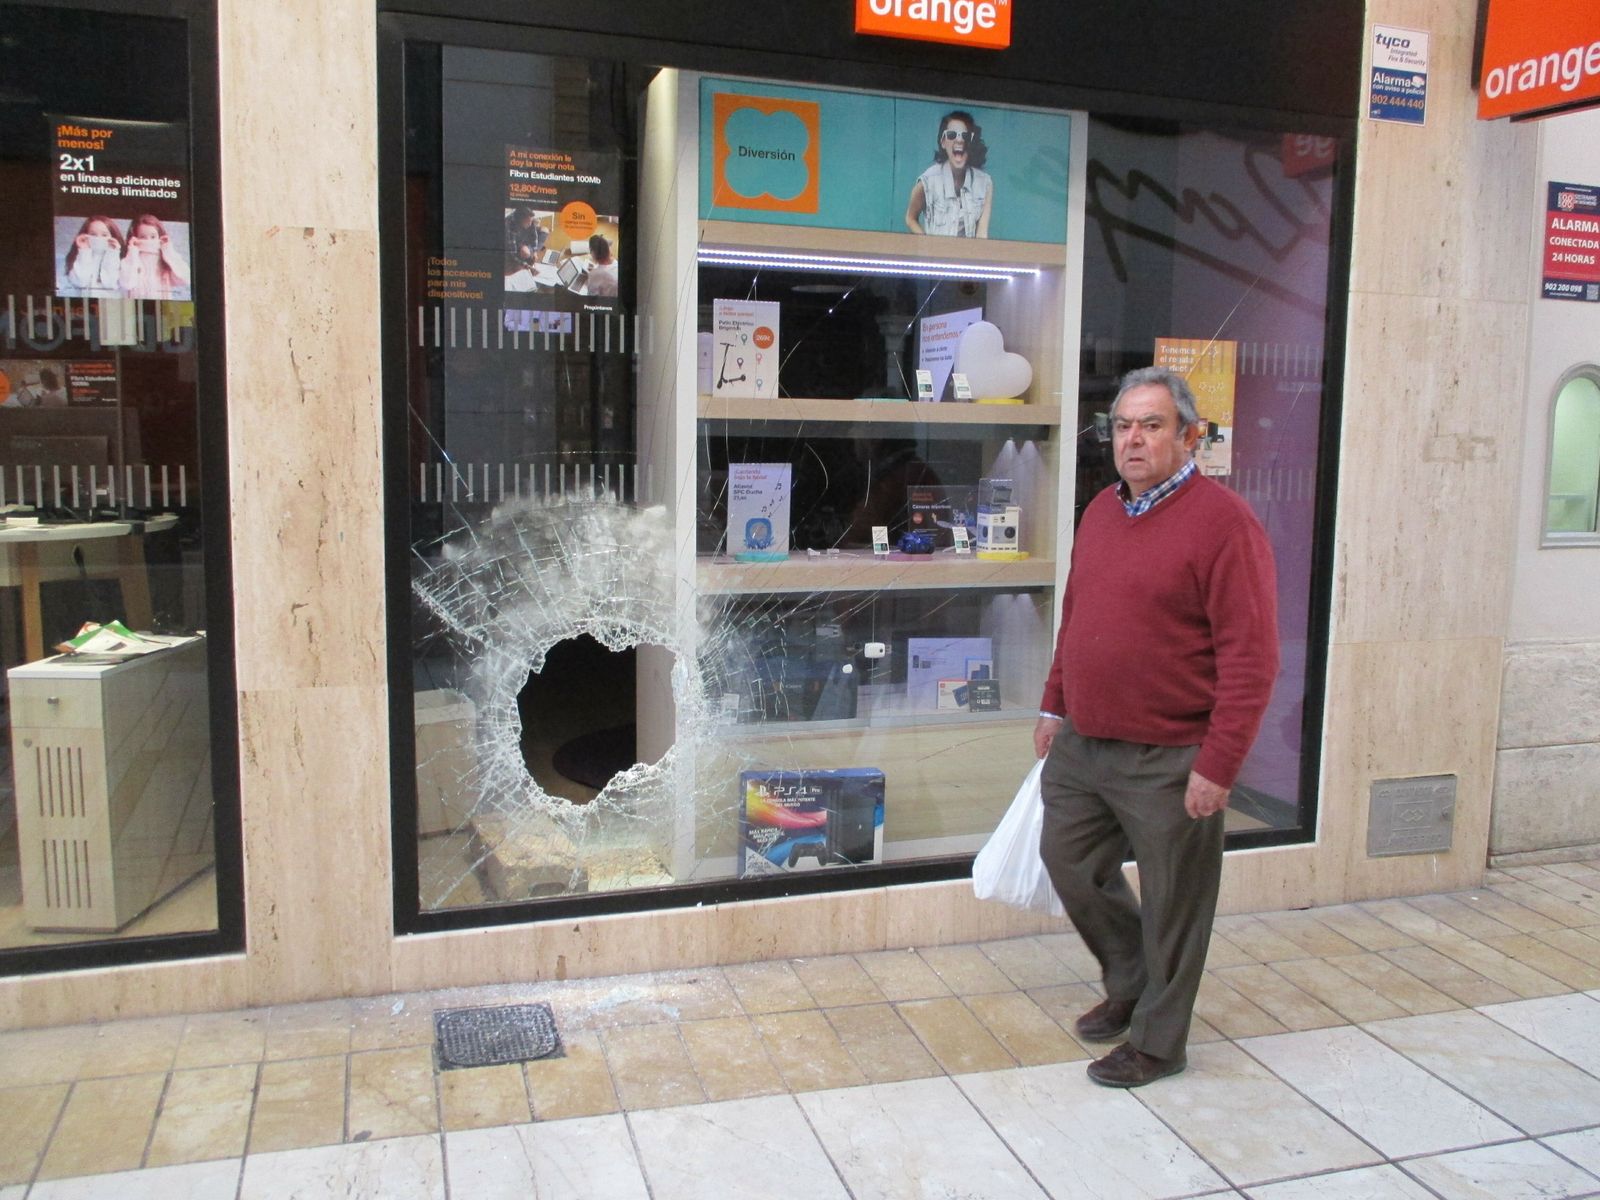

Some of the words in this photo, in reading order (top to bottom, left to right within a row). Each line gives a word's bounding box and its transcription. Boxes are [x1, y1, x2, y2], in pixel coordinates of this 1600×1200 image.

[869, 0, 997, 34] orange
[1375, 33, 1410, 49] tyco
[1485, 41, 1600, 99] orange
[1373, 72, 1411, 87] Alarma
[1371, 94, 1388, 105] 902
[1389, 96, 1406, 107] 444
[1407, 98, 1424, 109] 440
[58, 125, 88, 137] ¡Más
[91, 129, 113, 139] por
[58, 139, 105, 150] menos!
[738, 146, 796, 160] Diversión
[60, 153, 95, 171] 2x1
[558, 163, 575, 171] nota
[60, 173, 75, 181] en
[78, 172, 113, 184] líneas
[115, 175, 181, 188] adicionales
[509, 169, 529, 178] Fibra
[530, 171, 574, 182] Estudiantes
[576, 175, 601, 185] 100Mb
[71, 184, 119, 196] minutos
[122, 186, 177, 199] ilimitados
[572, 212, 585, 220] Sin
[1551, 217, 1600, 234] ALARMA
[1549, 236, 1600, 250] CONECTADA
[1552, 252, 1563, 262] 24
[1564, 253, 1595, 265] HORAS
[1544, 282, 1557, 291] 902
